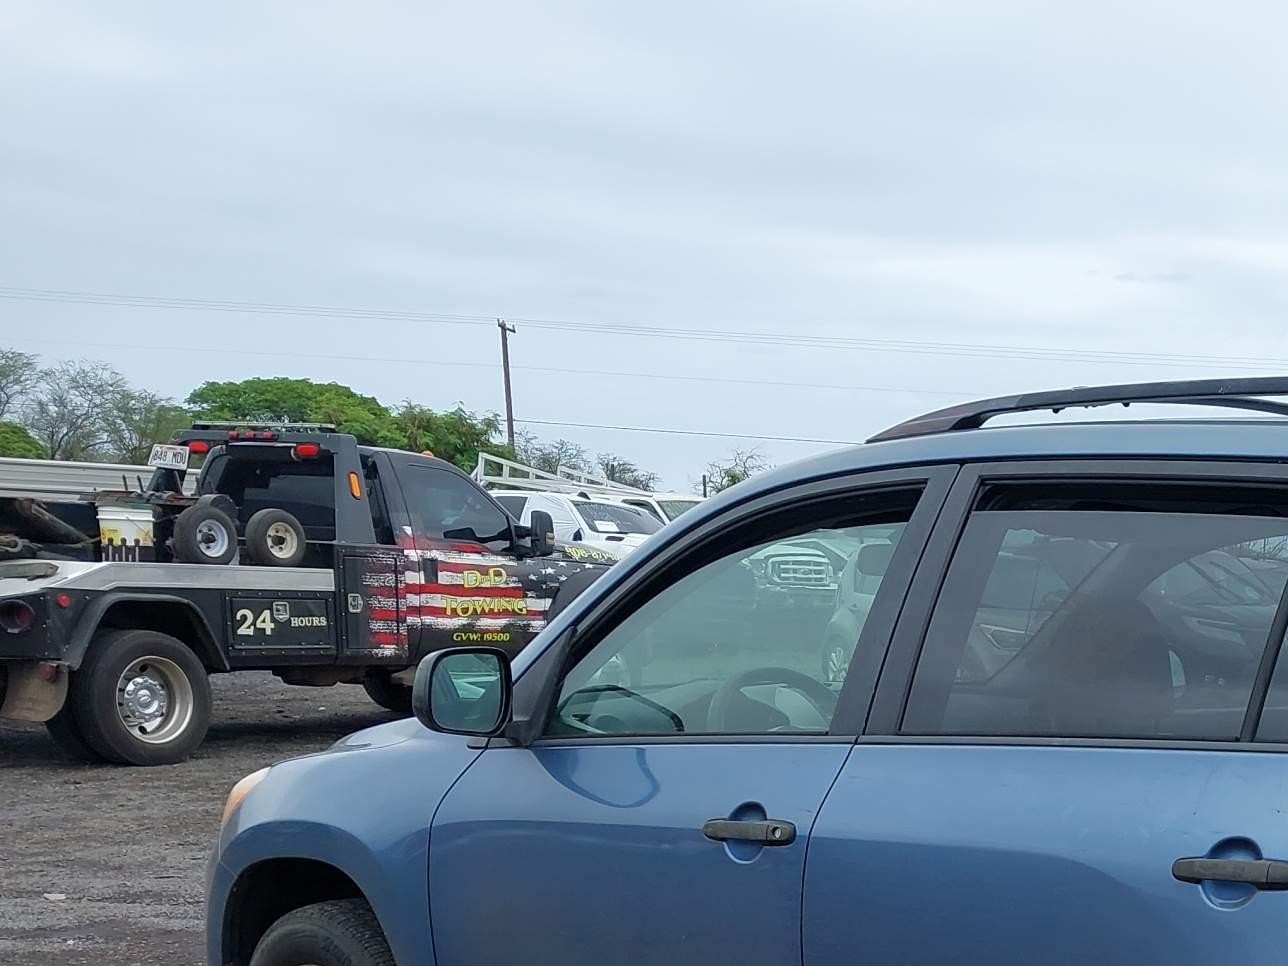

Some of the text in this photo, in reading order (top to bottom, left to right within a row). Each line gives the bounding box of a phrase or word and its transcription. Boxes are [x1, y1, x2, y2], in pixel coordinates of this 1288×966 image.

[463, 570, 481, 588] D
[488, 567, 507, 586] D
[441, 596, 528, 617] TOWING
[236, 608, 327, 636] 24 HOURS
[483, 632, 510, 641] 19500
